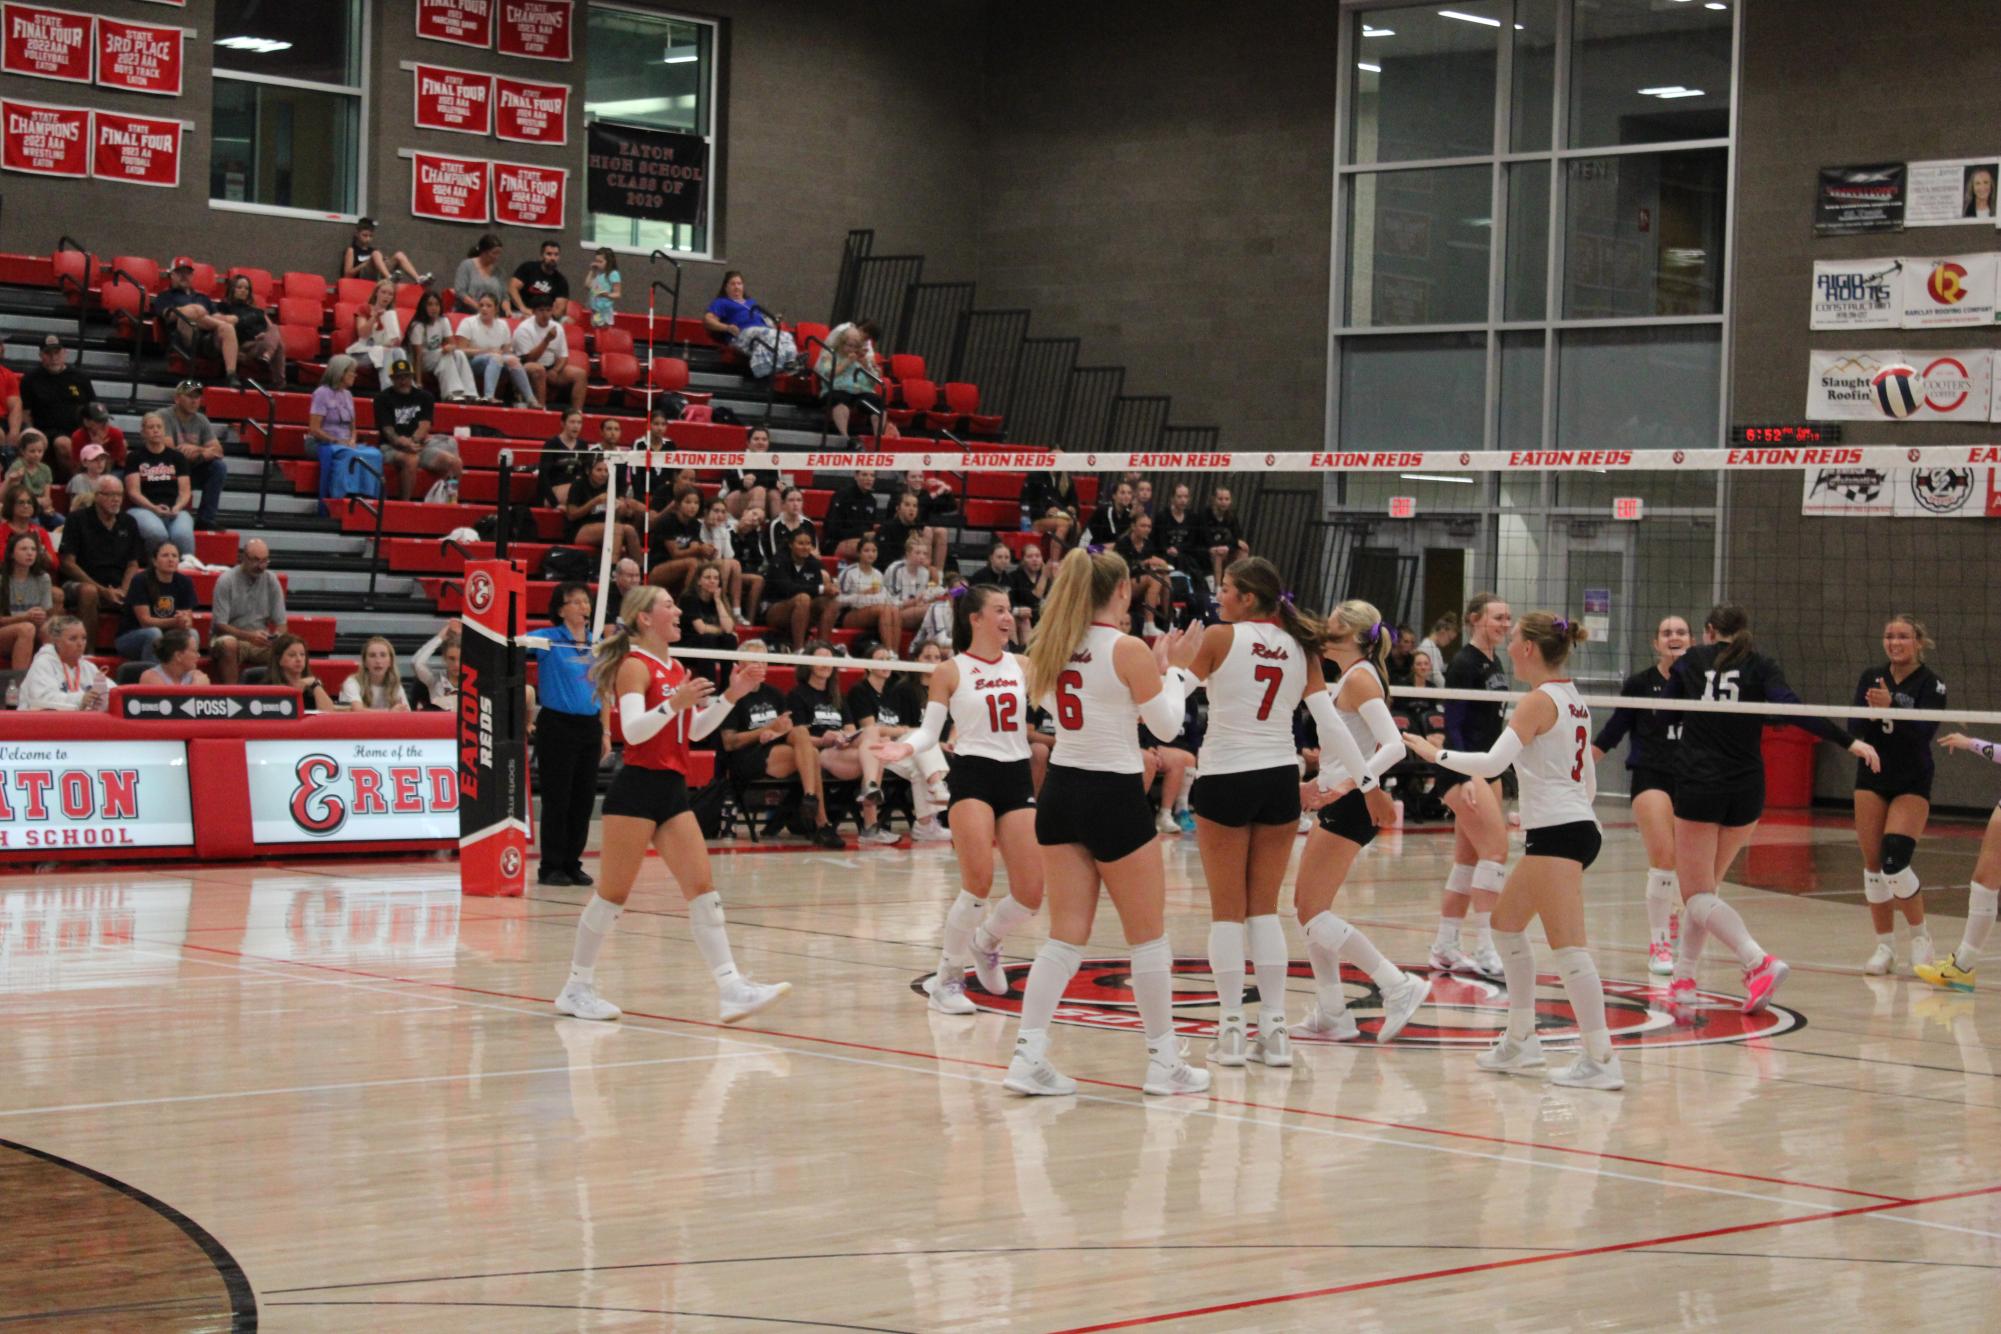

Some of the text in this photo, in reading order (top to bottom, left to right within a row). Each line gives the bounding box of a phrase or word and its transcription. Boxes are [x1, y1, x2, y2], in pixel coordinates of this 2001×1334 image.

[34, 14, 63, 27] STATE
[507, 5, 563, 28] CHAMPIONS
[13, 16, 83, 49] FINAL FOUR
[126, 29, 154, 42] STATE
[24, 49, 70, 65] VOLLEYBALL
[50, 41, 68, 54] AAA
[105, 33, 171, 61] 3RD PLACE
[141, 54, 158, 67] AAA
[136, 66, 160, 78] TRACK
[422, 76, 486, 103] FINAL FOUR
[500, 89, 562, 115] FINAL FOUR
[9, 113, 80, 141] CHAMPIONS
[31, 111, 60, 123] STATE
[100, 126, 173, 154] FINAL FOUR
[619, 141, 675, 161] EATON
[421, 163, 481, 191] CHAMPIONS
[440, 161, 465, 174] STATE
[589, 154, 703, 181] HIGH SCHOOL
[499, 173, 558, 199] FINAL FOUR
[607, 173, 684, 194] CLASS OF
[1827, 389, 1872, 401] Roofin
[664, 453, 708, 465] EATON
[709, 454, 745, 465] REDS
[806, 454, 853, 466] EATON
[855, 454, 894, 466] REDS
[961, 453, 1012, 466] EATON
[1014, 454, 1056, 467] REDS
[1129, 454, 1182, 467] EATON
[1186, 454, 1231, 467] REDS
[1310, 453, 1370, 467] EATON
[1372, 453, 1423, 467] REDS
[1509, 451, 1575, 466] EATON
[1577, 450, 1632, 466] REDS
[1727, 449, 1800, 465] EATON
[1801, 449, 1863, 465] REDS
[1616, 497, 1637, 518] EXIT
[1069, 648, 1092, 664] eds
[1251, 642, 1289, 660] Reds
[974, 677, 1018, 690] Eaton
[1254, 664, 1284, 721] 7
[1701, 669, 1740, 702] 15
[196, 700, 228, 716] POSS
[1056, 669, 1085, 731] 6
[985, 692, 1019, 732] 12
[1568, 703, 1589, 719] Reds
[460, 663, 479, 800] EATON
[480, 696, 493, 769] REDS
[56, 748, 69, 761] to
[353, 744, 423, 760] Home of the
[1571, 725, 1588, 783] 3
[26, 828, 134, 846] SCHOOL
